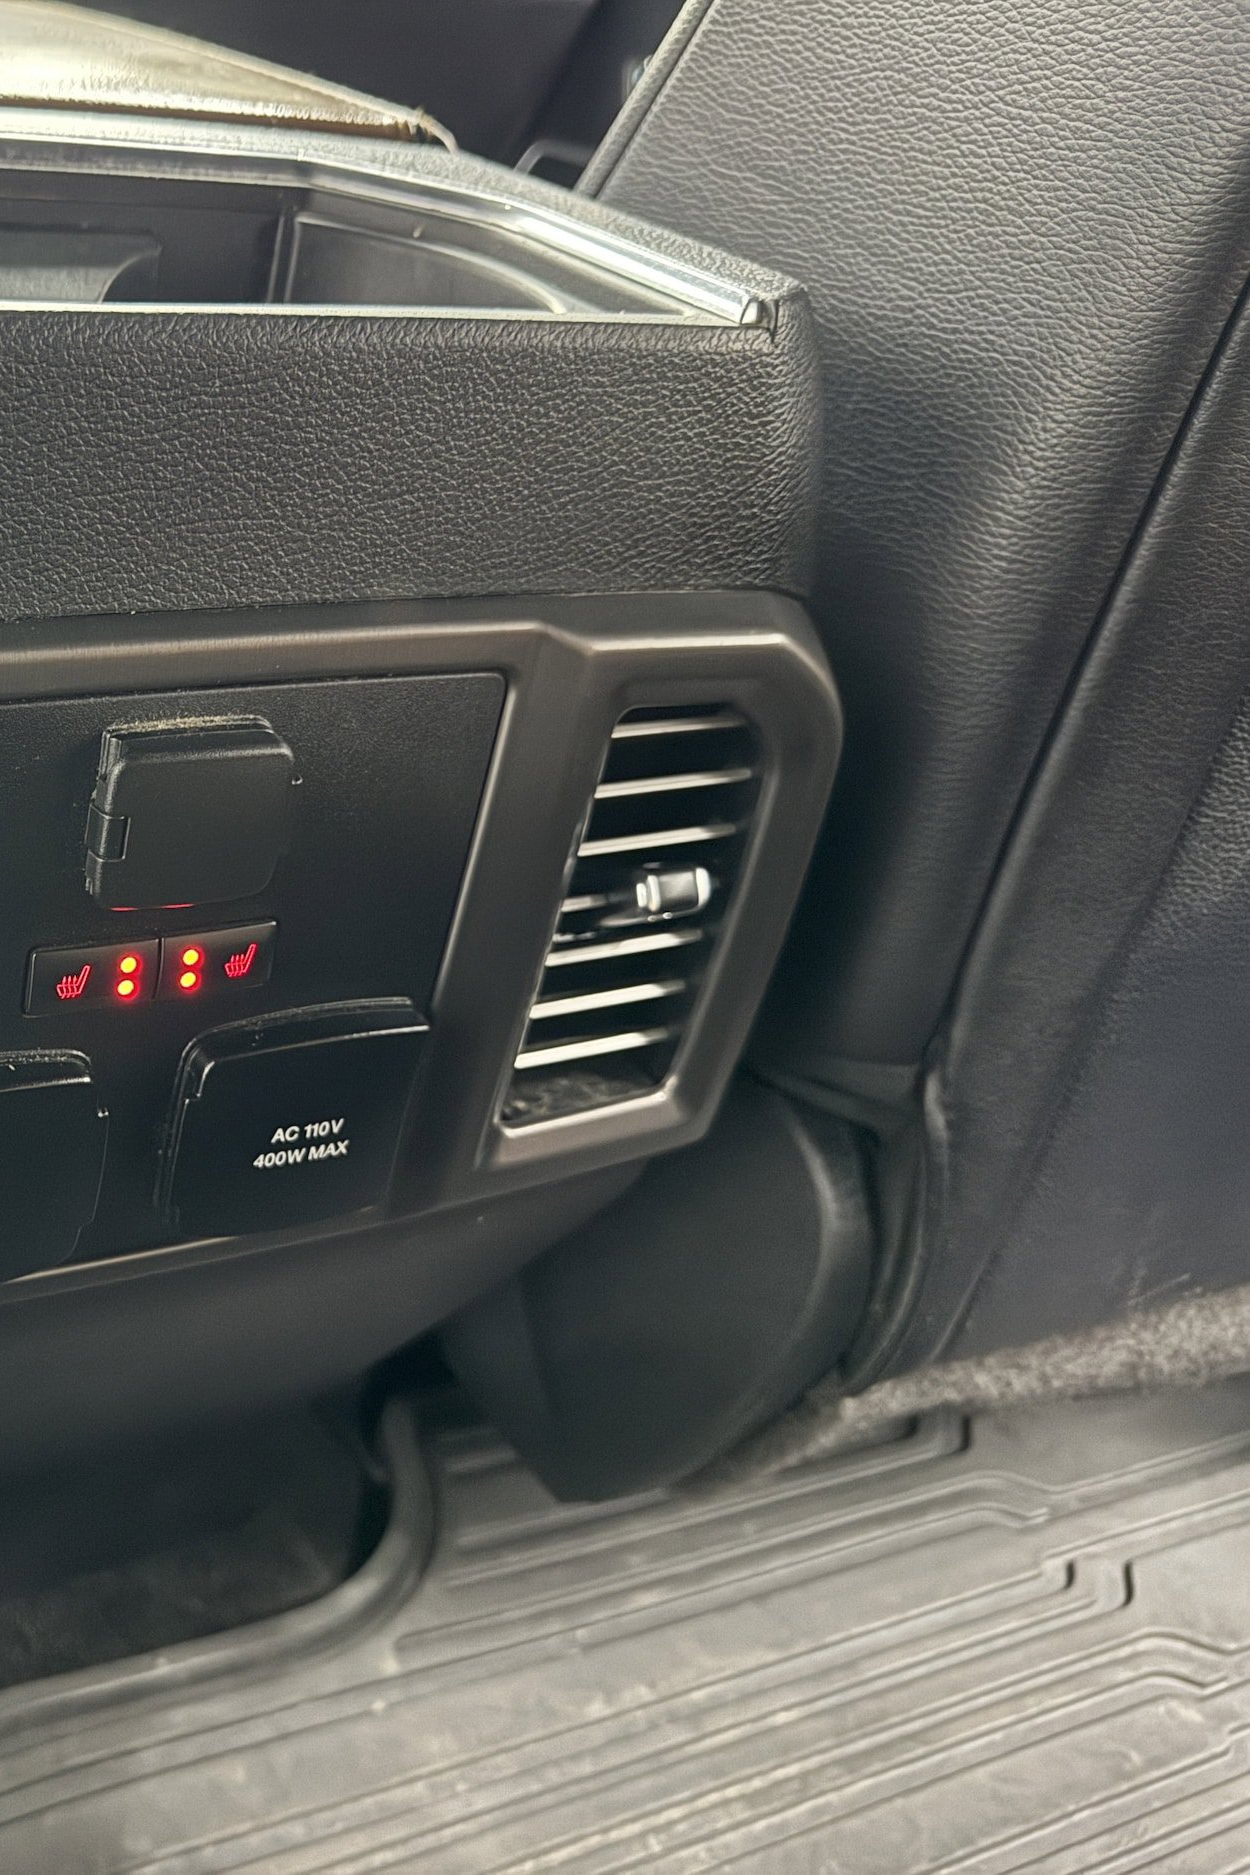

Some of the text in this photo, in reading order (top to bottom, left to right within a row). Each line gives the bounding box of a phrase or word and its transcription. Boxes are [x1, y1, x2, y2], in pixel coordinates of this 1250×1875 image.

[270, 1118, 345, 1143] AC 110V
[253, 1140, 349, 1168] 400W MAX
